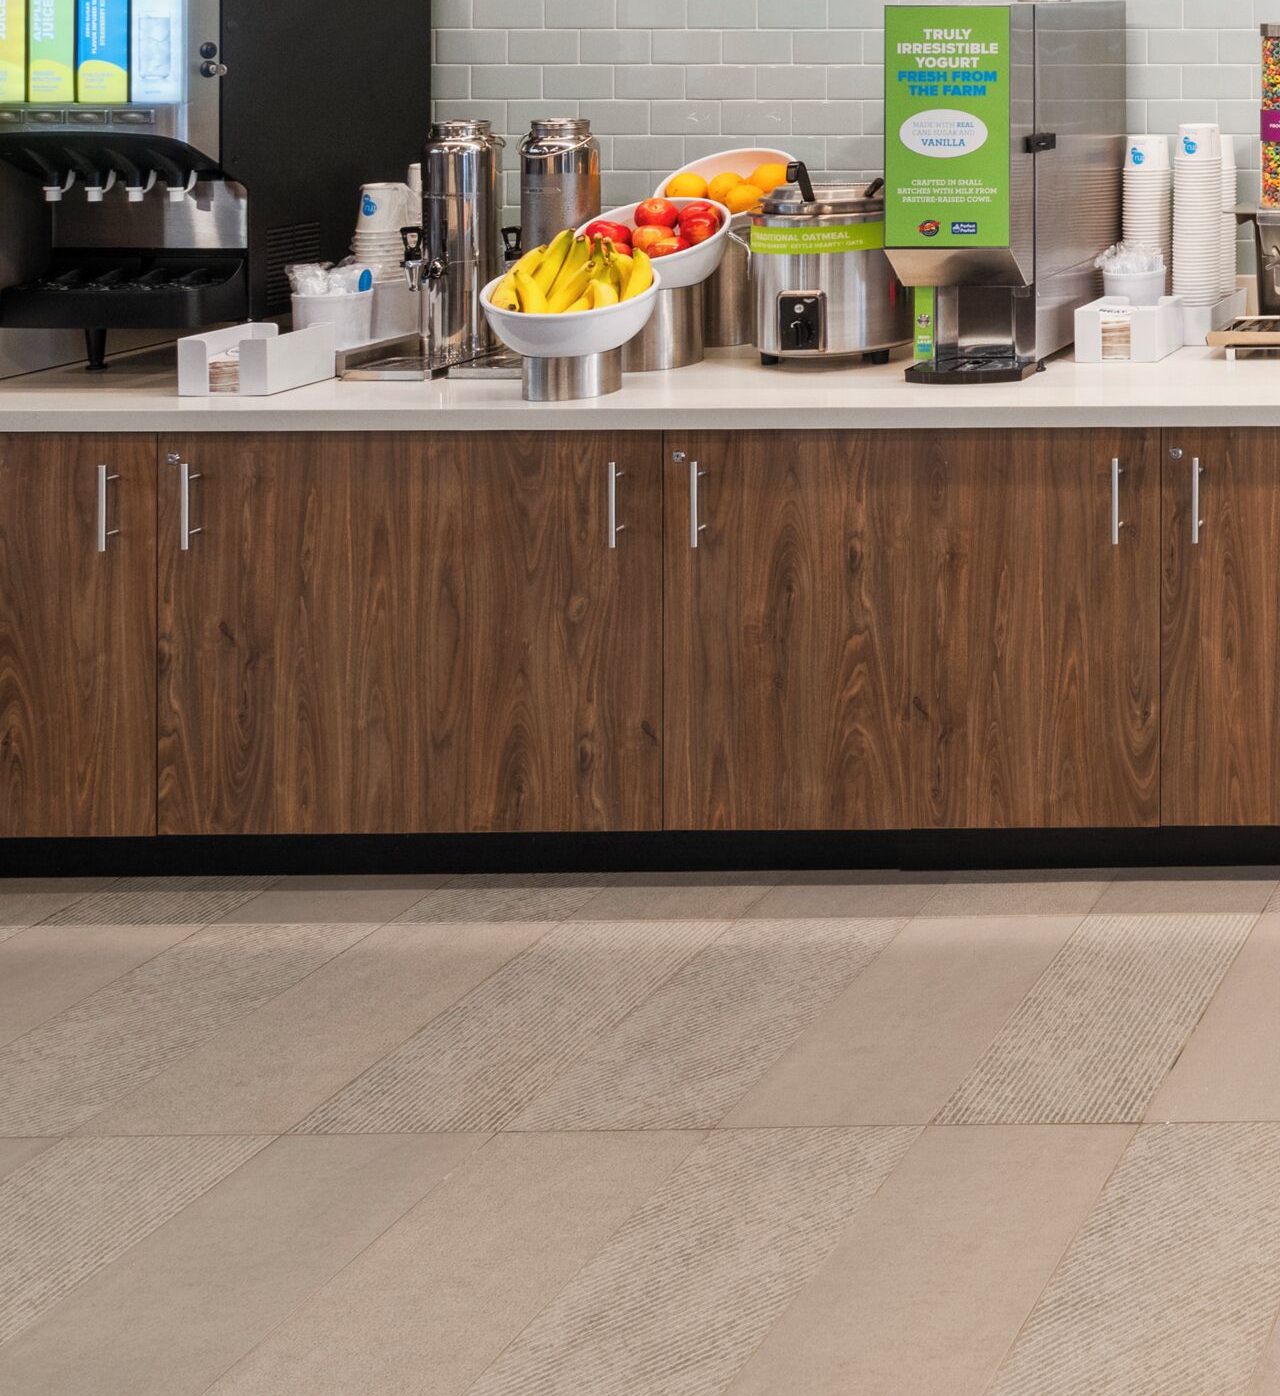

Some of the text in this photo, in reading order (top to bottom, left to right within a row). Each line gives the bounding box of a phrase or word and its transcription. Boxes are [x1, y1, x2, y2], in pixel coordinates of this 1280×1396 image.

[923, 29, 972, 40] TRULY
[897, 43, 999, 54] IRRESISTIBLE
[915, 57, 980, 68] YOGURT
[898, 70, 997, 82] FRESH FROM
[908, 85, 986, 96] THE FARM
[801, 231, 850, 242] OATMEAL
